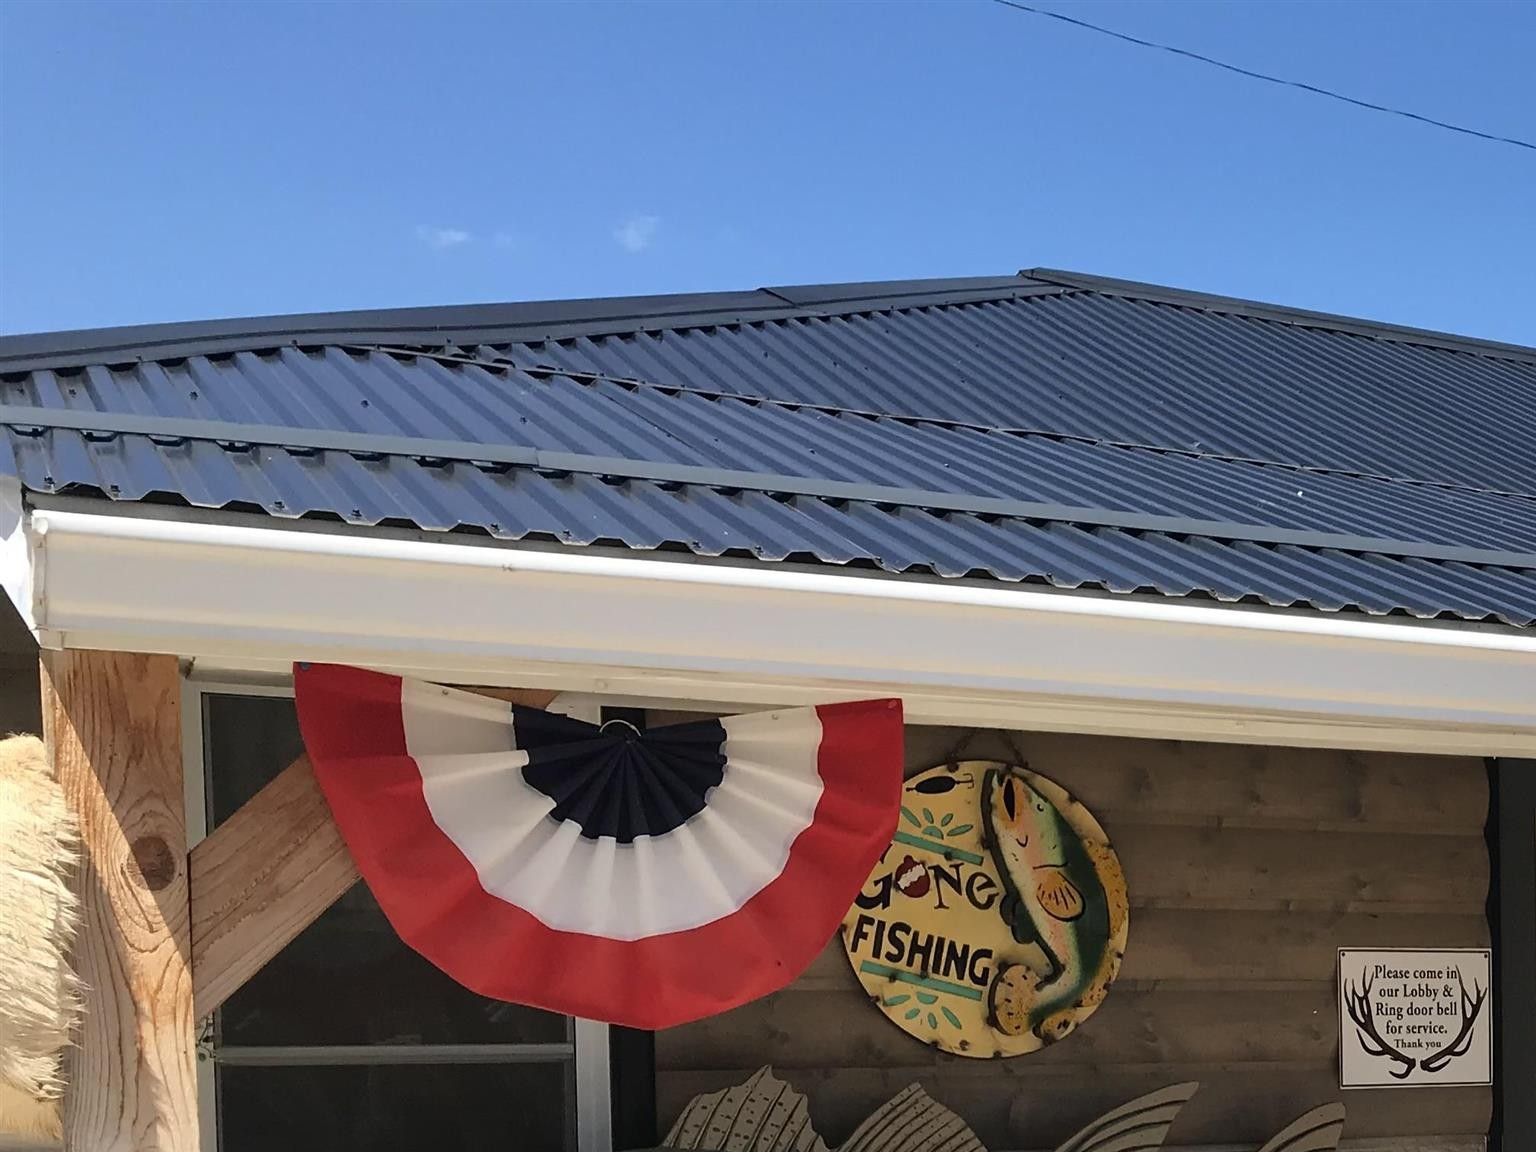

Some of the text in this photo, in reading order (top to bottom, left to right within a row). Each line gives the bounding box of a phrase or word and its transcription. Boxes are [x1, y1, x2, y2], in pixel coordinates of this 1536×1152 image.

[850, 914, 994, 987] FISHING
[1374, 965, 1458, 979] Please come in
[1379, 984, 1454, 1001] our Lobby &
[1375, 1002, 1458, 1021] Ring door bell
[1385, 1020, 1448, 1035] for service.
[1393, 1038, 1442, 1050] Thank you
